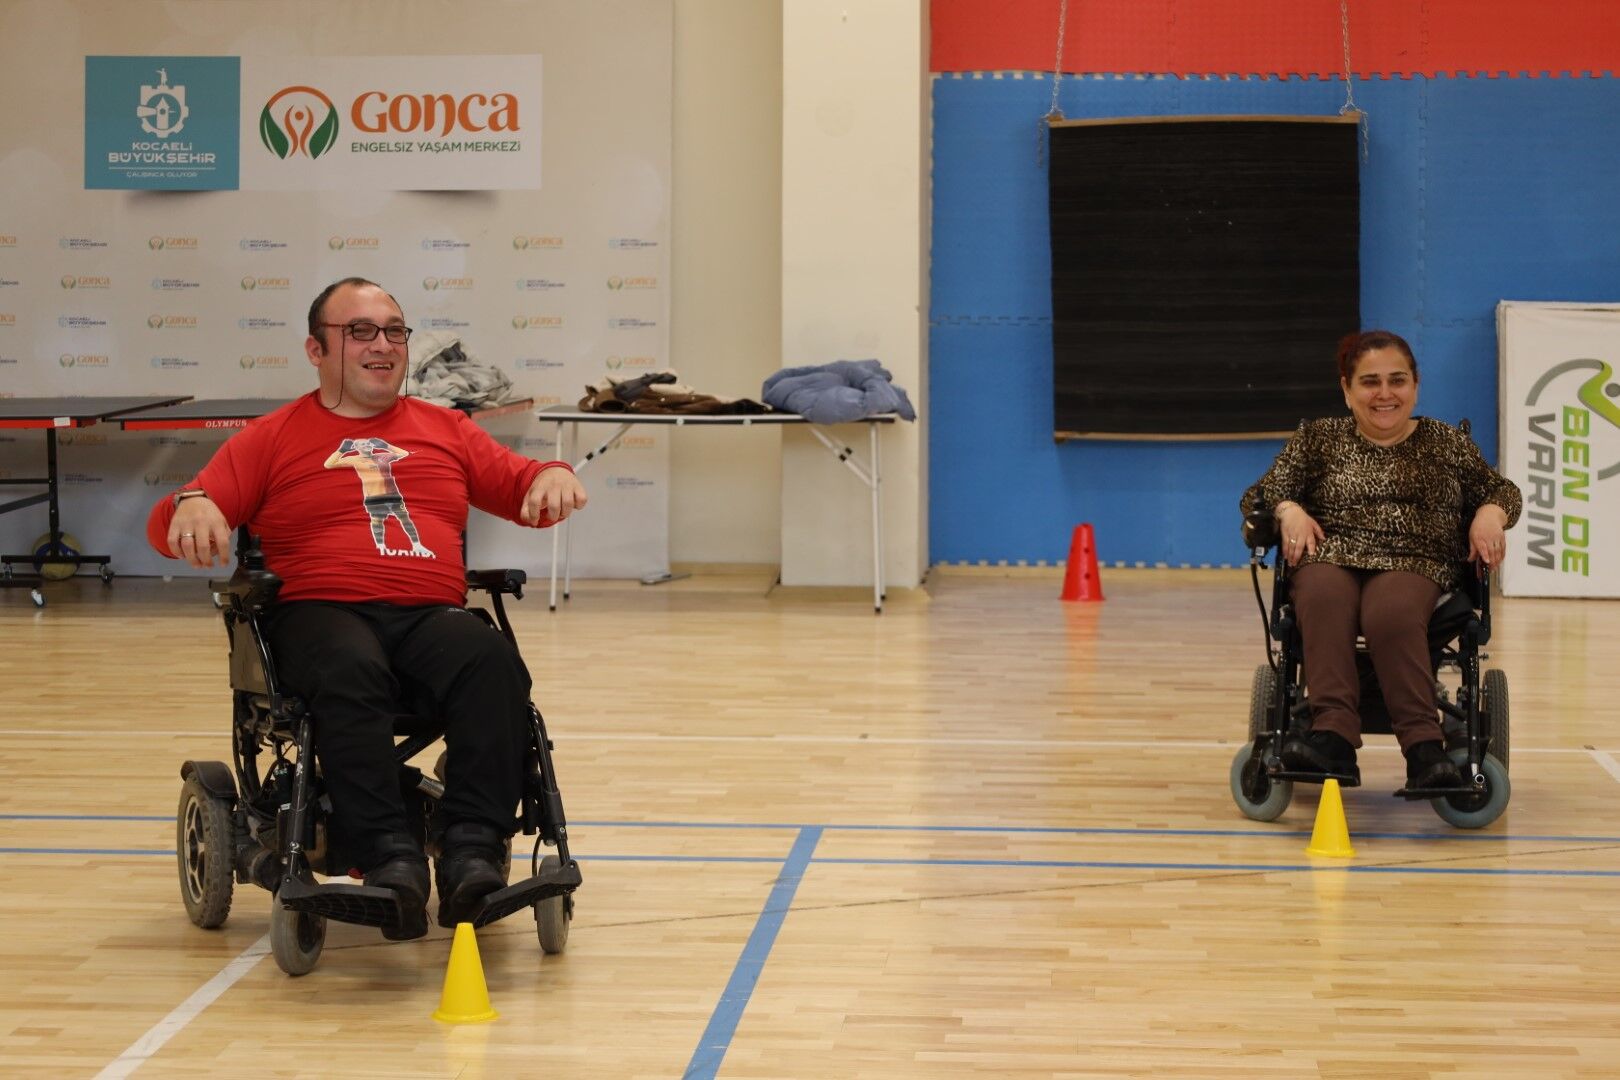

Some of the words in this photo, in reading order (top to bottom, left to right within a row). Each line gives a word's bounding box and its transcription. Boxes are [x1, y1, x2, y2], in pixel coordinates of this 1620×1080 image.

[351, 91, 520, 137] Gonca
[108, 151, 216, 164] BÜYÜKŞEHİR
[351, 141, 413, 153] ENGELSİZ
[417, 141, 462, 154] YAŞAM
[463, 140, 521, 152] MERKEZİ
[205, 419, 247, 428] OLYMPUS
[1562, 405, 1590, 503] BEN
[1527, 413, 1556, 571] VARIM
[1562, 514, 1590, 577] DE
